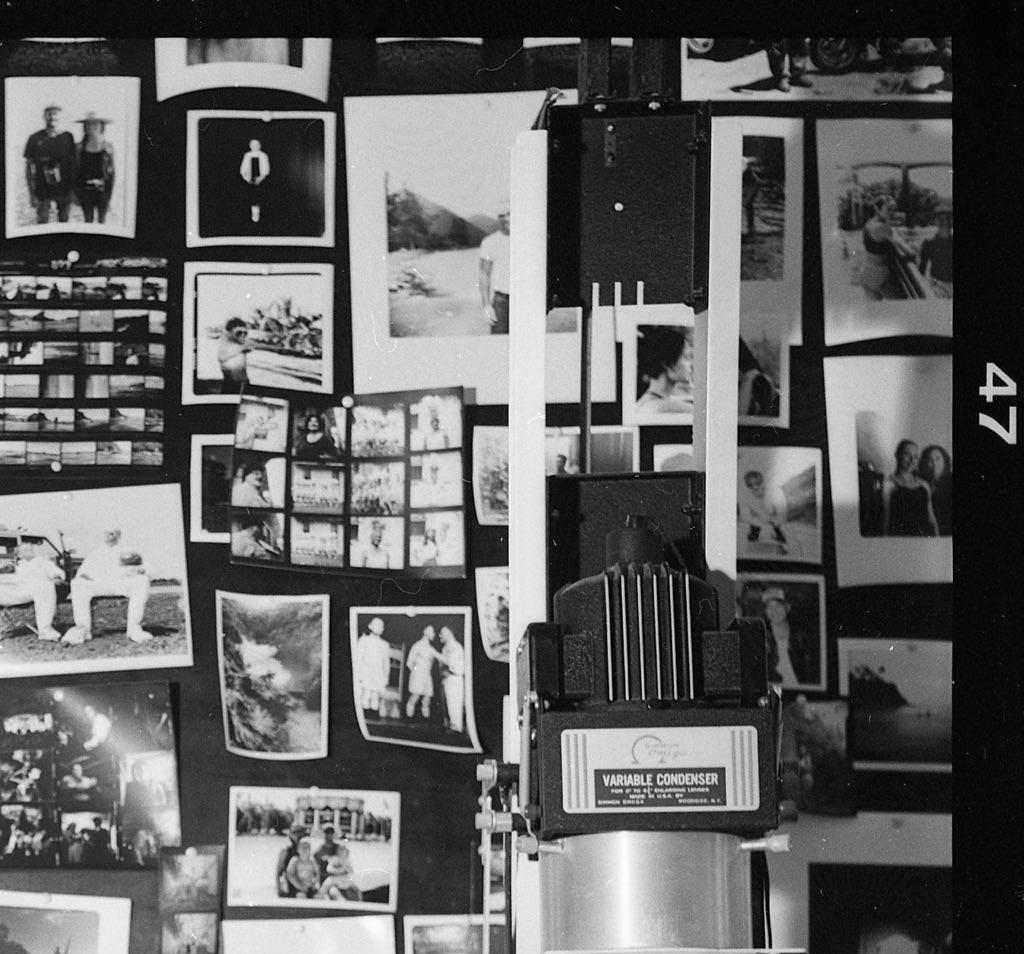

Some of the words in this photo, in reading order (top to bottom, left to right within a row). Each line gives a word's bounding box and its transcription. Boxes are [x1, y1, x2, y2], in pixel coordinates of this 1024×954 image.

[978, 361, 1017, 445] 47
[602, 773, 653, 787] VARIABLE
[656, 772, 718, 786] CONDENSER
